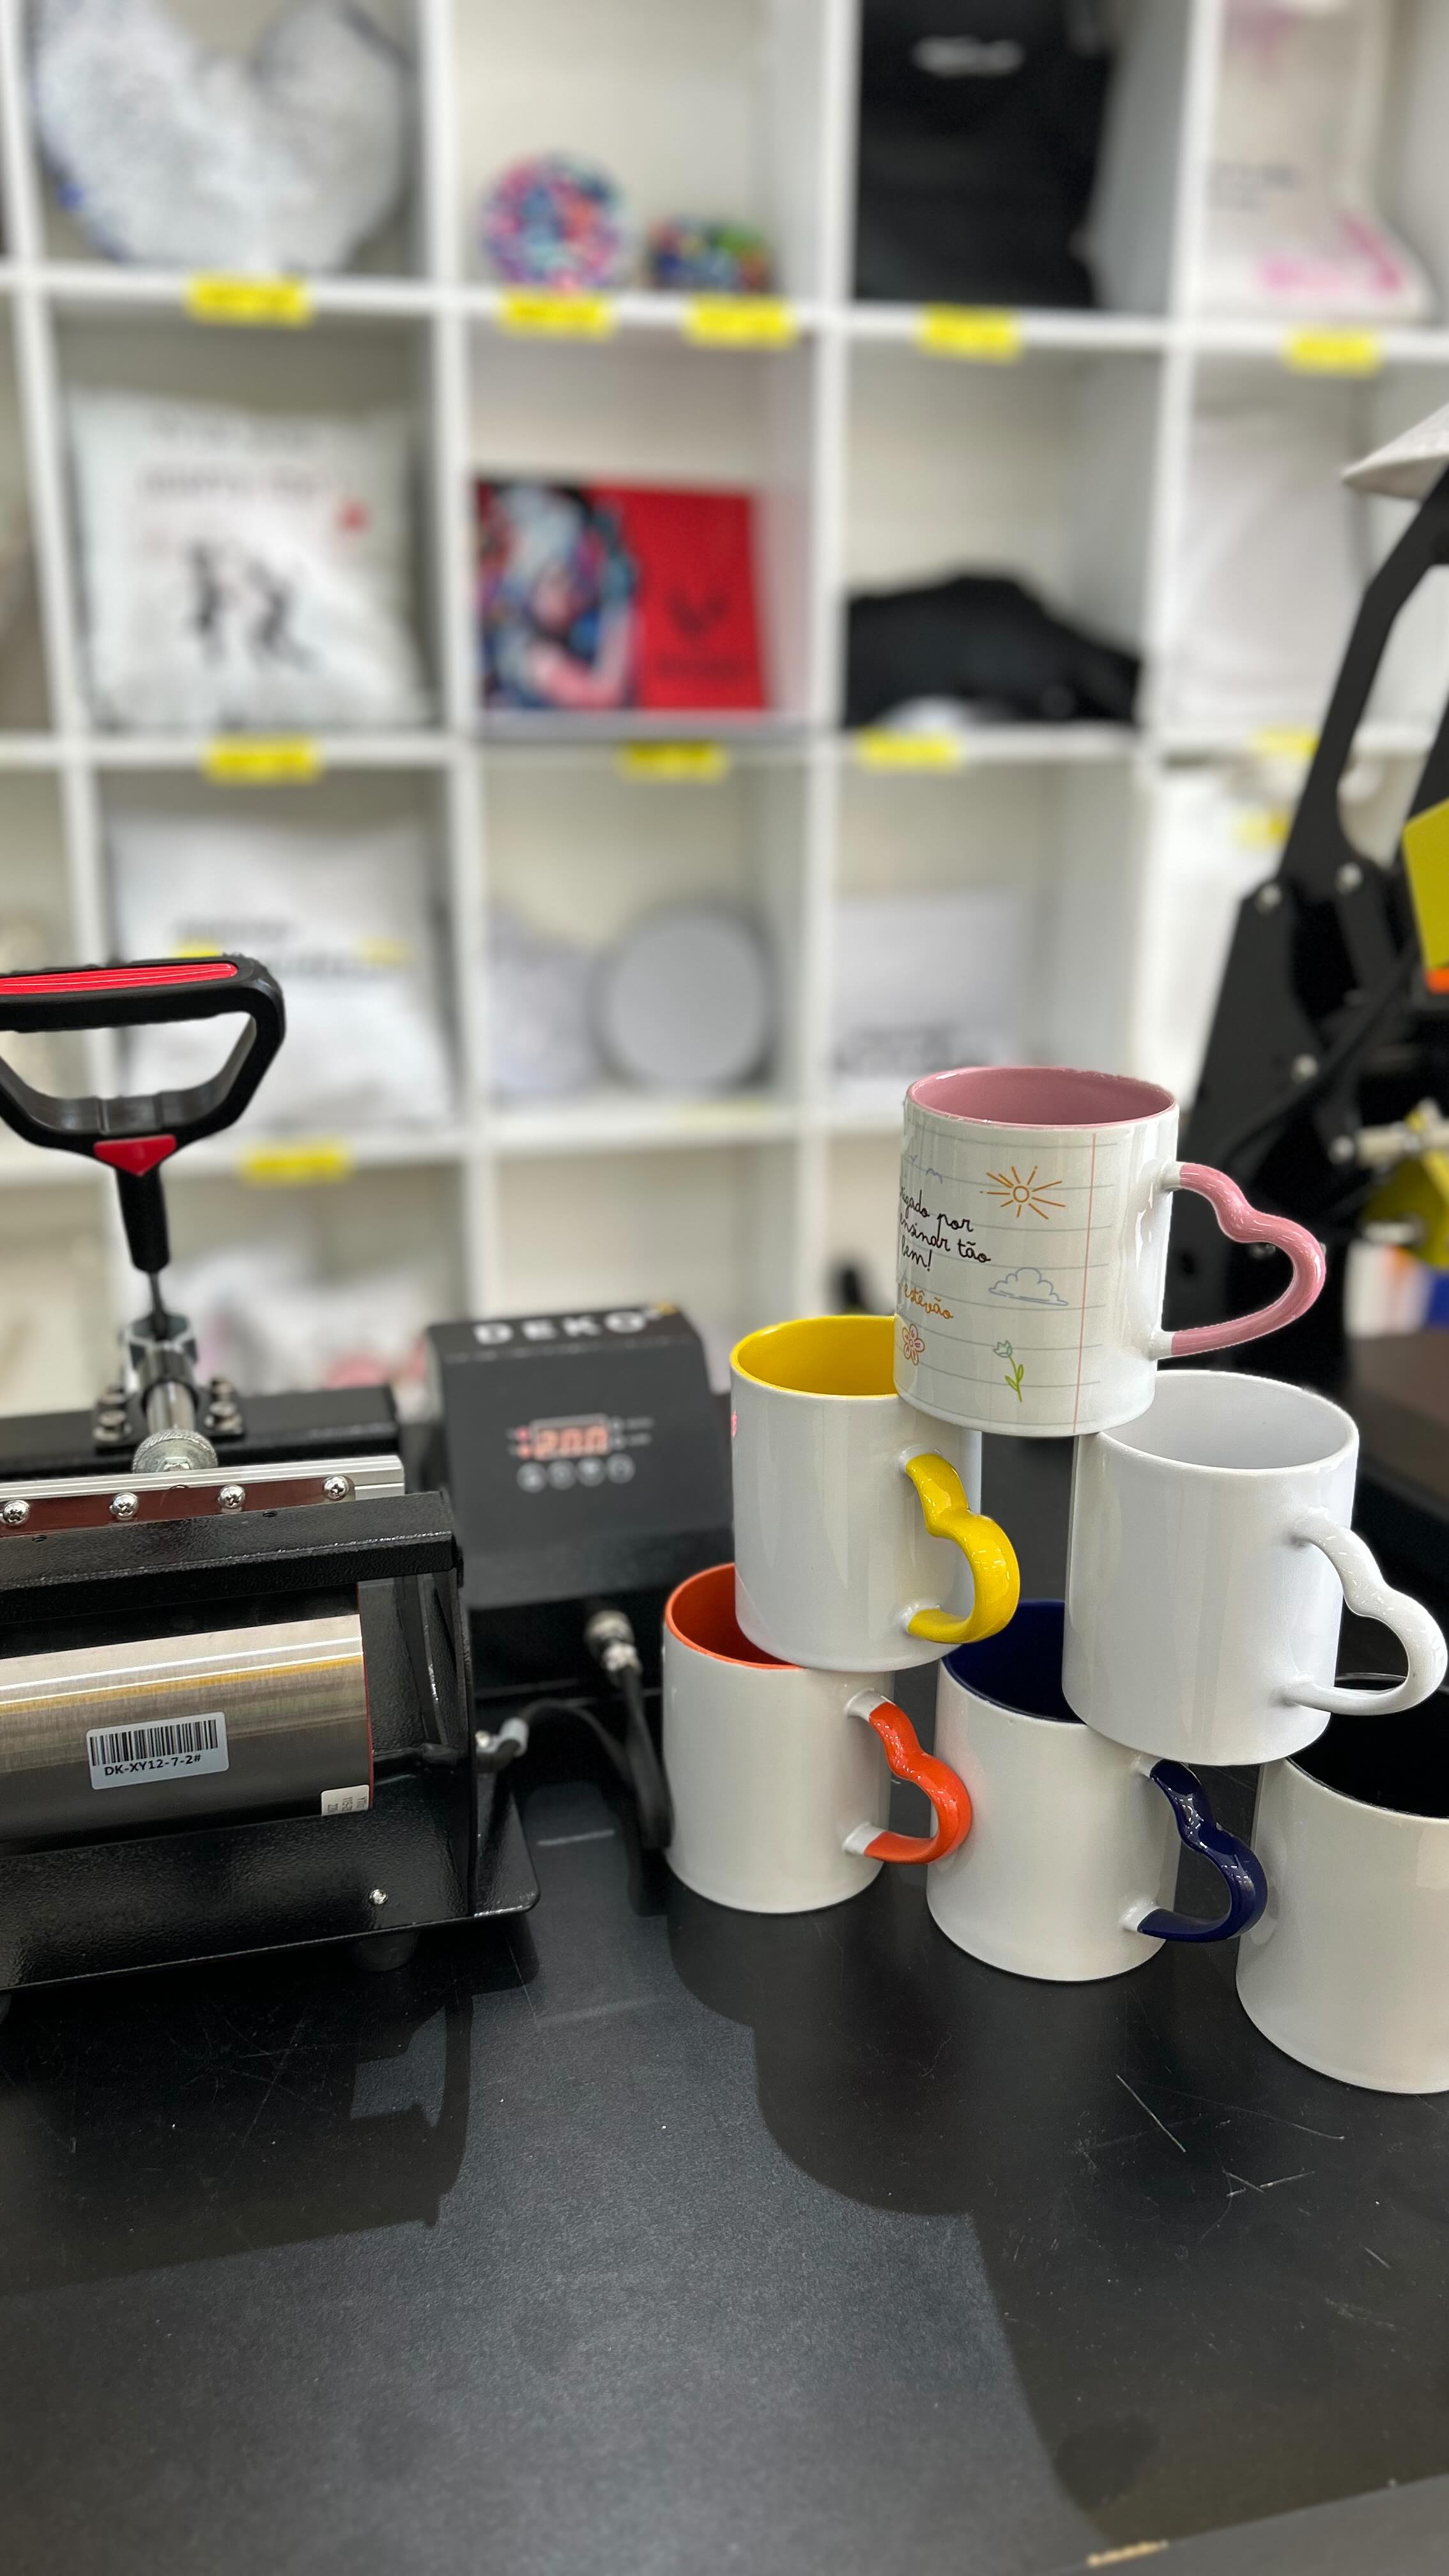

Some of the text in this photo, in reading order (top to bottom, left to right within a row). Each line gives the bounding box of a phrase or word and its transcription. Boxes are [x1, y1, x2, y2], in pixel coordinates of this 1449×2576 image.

[937, 1213, 974, 1242] por
[958, 1239, 991, 1263] tão
[475, 1311, 646, 1345] DEKO
[104, 1754, 201, 1776] DK-XY12-7-2#
